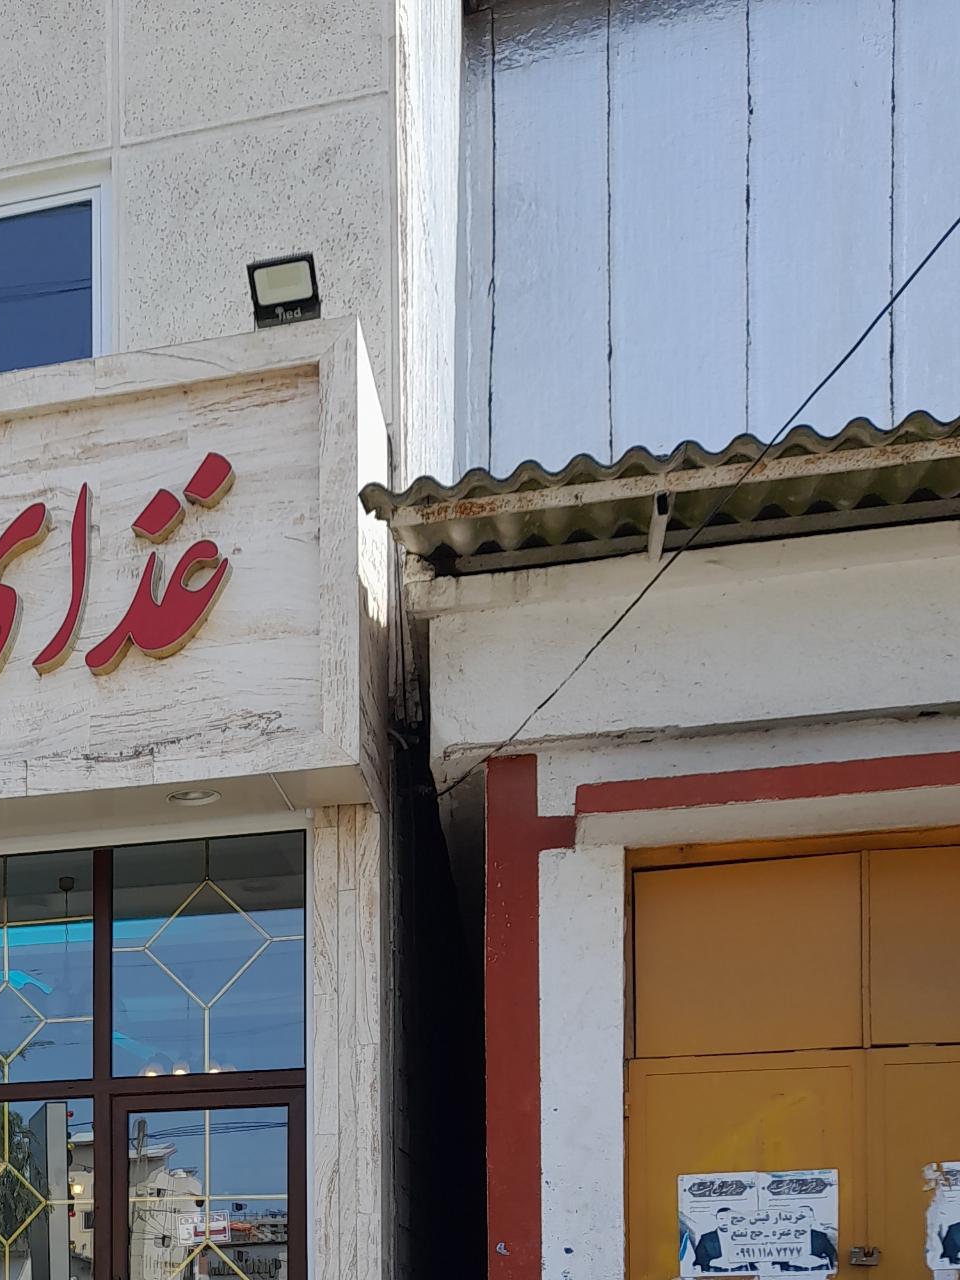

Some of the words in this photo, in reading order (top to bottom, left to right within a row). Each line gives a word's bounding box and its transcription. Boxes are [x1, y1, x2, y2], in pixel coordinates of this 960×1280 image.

[731, 1216, 746, 1225] حج
[749, 1211, 770, 1225] فیش
[773, 1211, 806, 1224] خریدار
[750, 1230, 763, 1240] حج
[794, 1229, 807, 1239] حج
